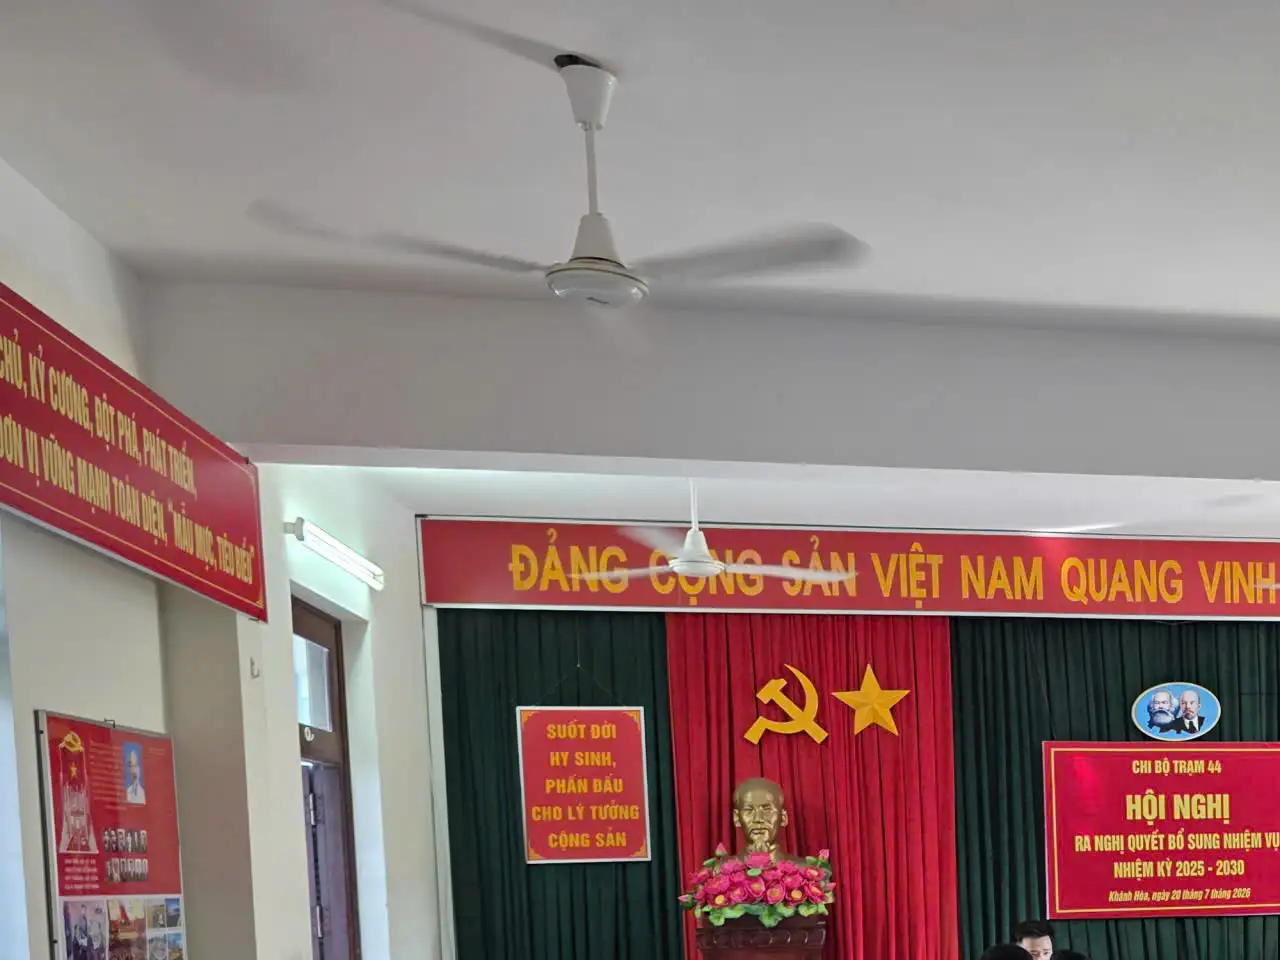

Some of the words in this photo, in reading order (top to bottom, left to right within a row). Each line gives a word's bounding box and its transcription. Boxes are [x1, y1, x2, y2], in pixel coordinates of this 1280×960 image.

[29, 344, 45, 404] KỶ
[49, 366, 94, 438] CƯƠNG,
[94, 392, 115, 452] ĐỘT
[117, 412, 142, 468] PHÁ,
[142, 428, 168, 477] PHÁT
[25, 428, 40, 487] VỊ
[41, 433, 75, 495] VỮNG
[76, 456, 112, 514] MẠNH
[112, 474, 140, 528] TOÀN
[509, 528, 629, 594] ĐẢNG
[781, 535, 857, 597] SẢN
[870, 541, 944, 609] VIỆT
[960, 555, 1044, 602] NAM
[1061, 556, 1184, 606] QUANG
[1199, 560, 1277, 605] VINH
[546, 720, 586, 739] SUỐT
[591, 720, 616, 739] ĐỜI
[550, 752, 569, 767] HY
[575, 752, 616, 768] SINH,
[1132, 760, 1152, 774] CHI
[1155, 758, 1168, 776] BỘ
[1174, 760, 1204, 776] TRẠM
[1208, 760, 1222, 774] 44
[545, 774, 588, 794] PHẤN
[593, 773, 624, 793] ĐẤU
[532, 805, 562, 821] CHO
[590, 800, 640, 820] TƯỞNG
[1126, 789, 1166, 826] HỘI
[1173, 794, 1230, 825] NGHỊ
[548, 830, 590, 851] CỘNG
[596, 827, 626, 848] SẢN
[1075, 835, 1091, 852] RA
[1094, 834, 1124, 854] NGHỊ
[1128, 829, 1164, 851] QUYẾT
[1168, 828, 1184, 850] BỔ
[1188, 834, 1220, 850] SUNG
[1223, 830, 1262, 852] NHIỆM
[1265, 832, 1280, 850] VỤ
[1114, 858, 1154, 881] NHIỆM
[1157, 857, 1172, 878] KỲ
[1176, 860, 1204, 877] 2025
[1216, 860, 1244, 876] 2030
